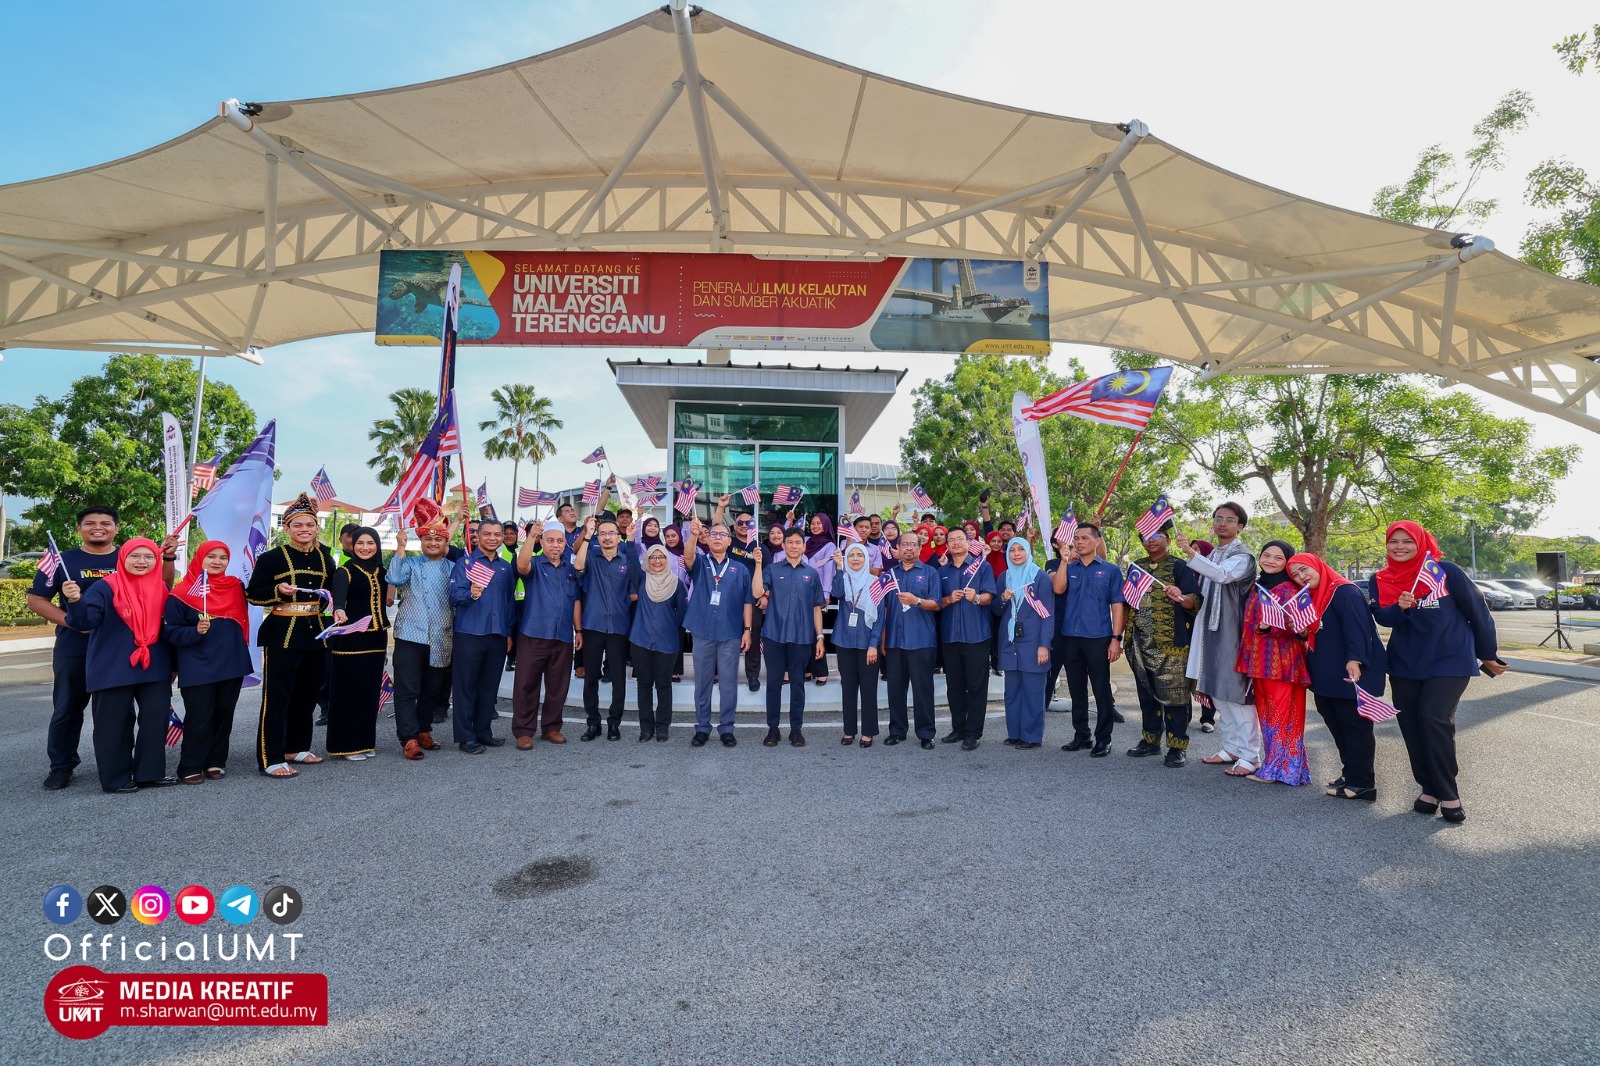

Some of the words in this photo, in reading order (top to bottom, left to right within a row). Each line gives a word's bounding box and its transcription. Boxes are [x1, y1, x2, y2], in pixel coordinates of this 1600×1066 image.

[514, 263, 570, 273] SELAMAT
[574, 264, 621, 274] DATANG
[626, 265, 641, 274] KE
[513, 274, 639, 295] UNIVERSITI
[693, 281, 760, 295] PENERAJU
[763, 283, 796, 295] ILMU
[799, 283, 867, 297] KELAUTAN
[512, 294, 628, 314] MALAYSIA
[692, 294, 720, 307] DAN
[723, 295, 778, 308] SUMBER
[781, 296, 836, 309] AKUATIK
[511, 313, 666, 334] TERENGGANU
